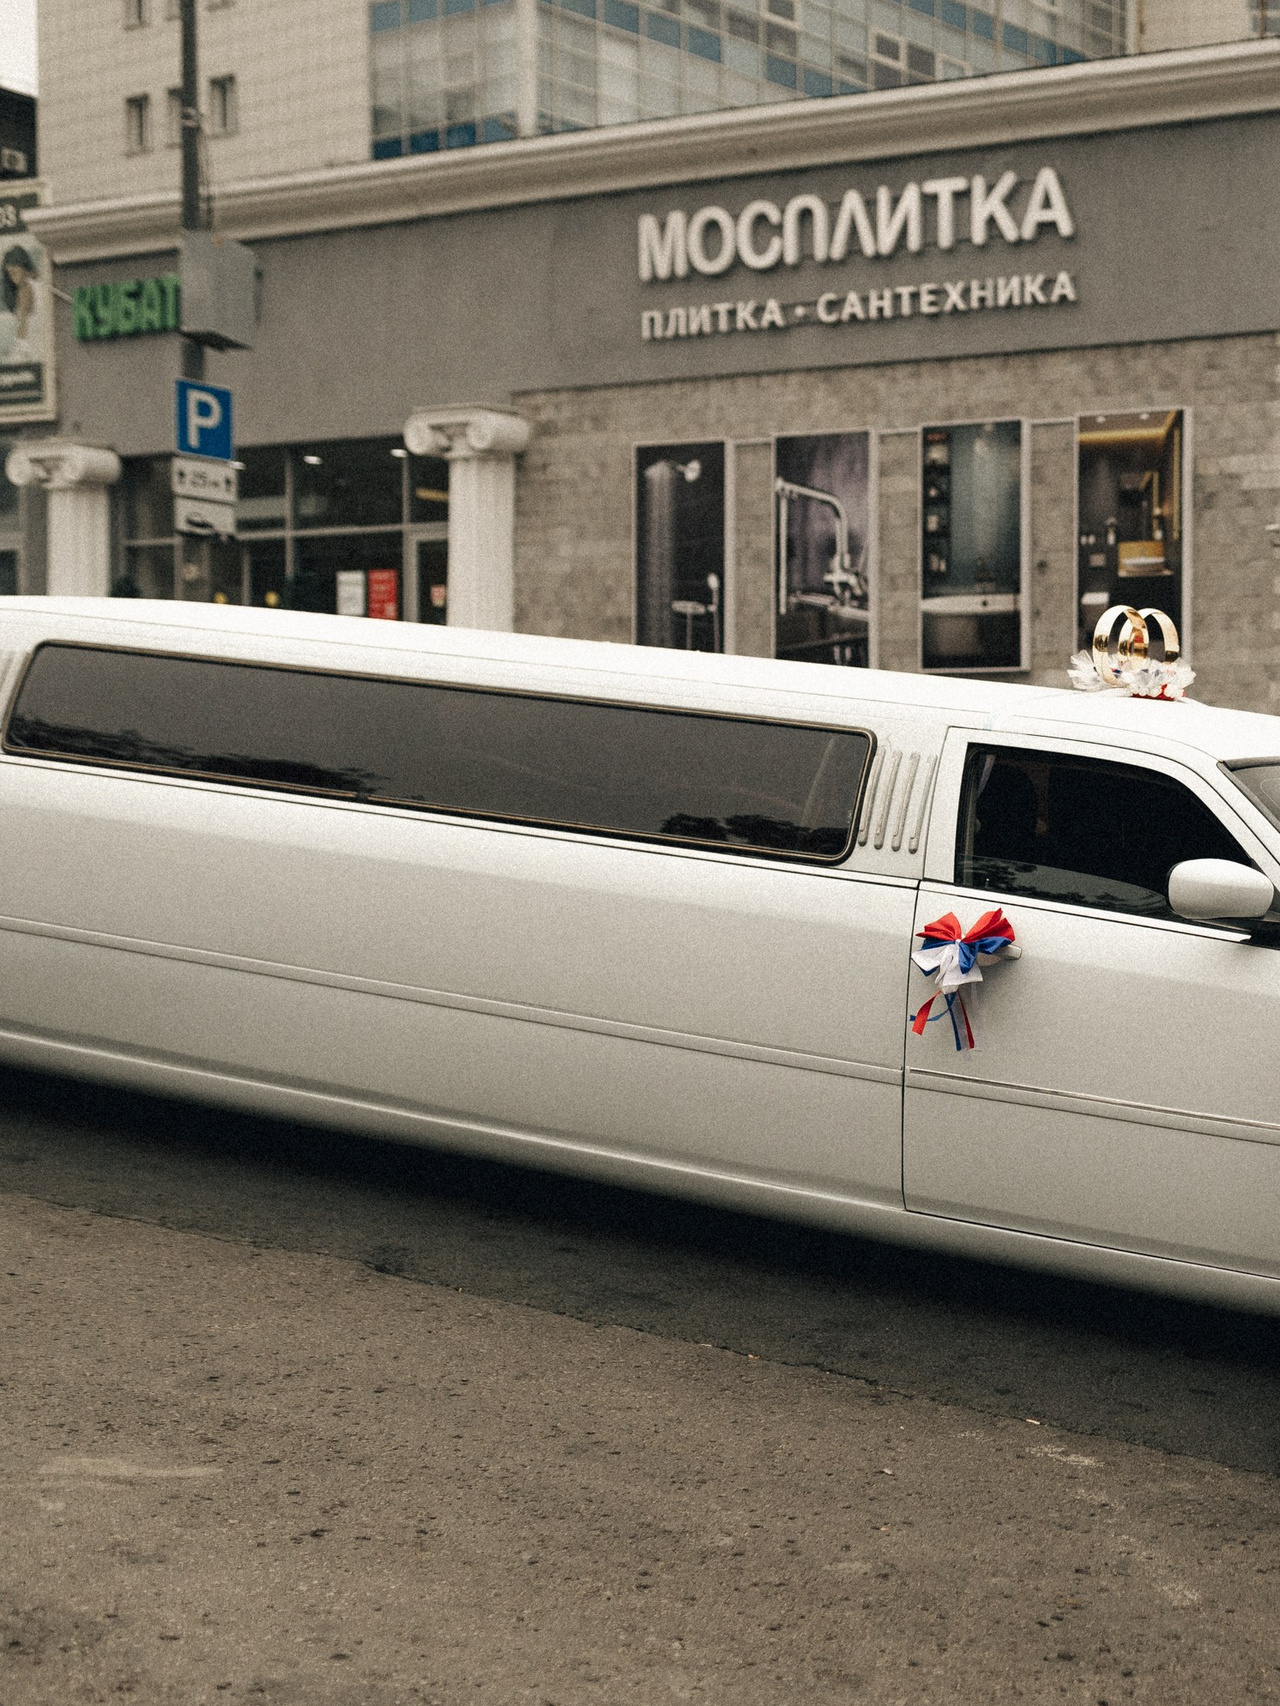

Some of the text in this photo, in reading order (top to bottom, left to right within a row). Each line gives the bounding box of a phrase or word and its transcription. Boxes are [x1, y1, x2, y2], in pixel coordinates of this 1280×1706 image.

[637, 166, 1076, 282] МОСПЛИТКА
[640, 270, 1078, 341] ПЛИТКА САНТЕХНИКА
[186, 387, 222, 449] P
